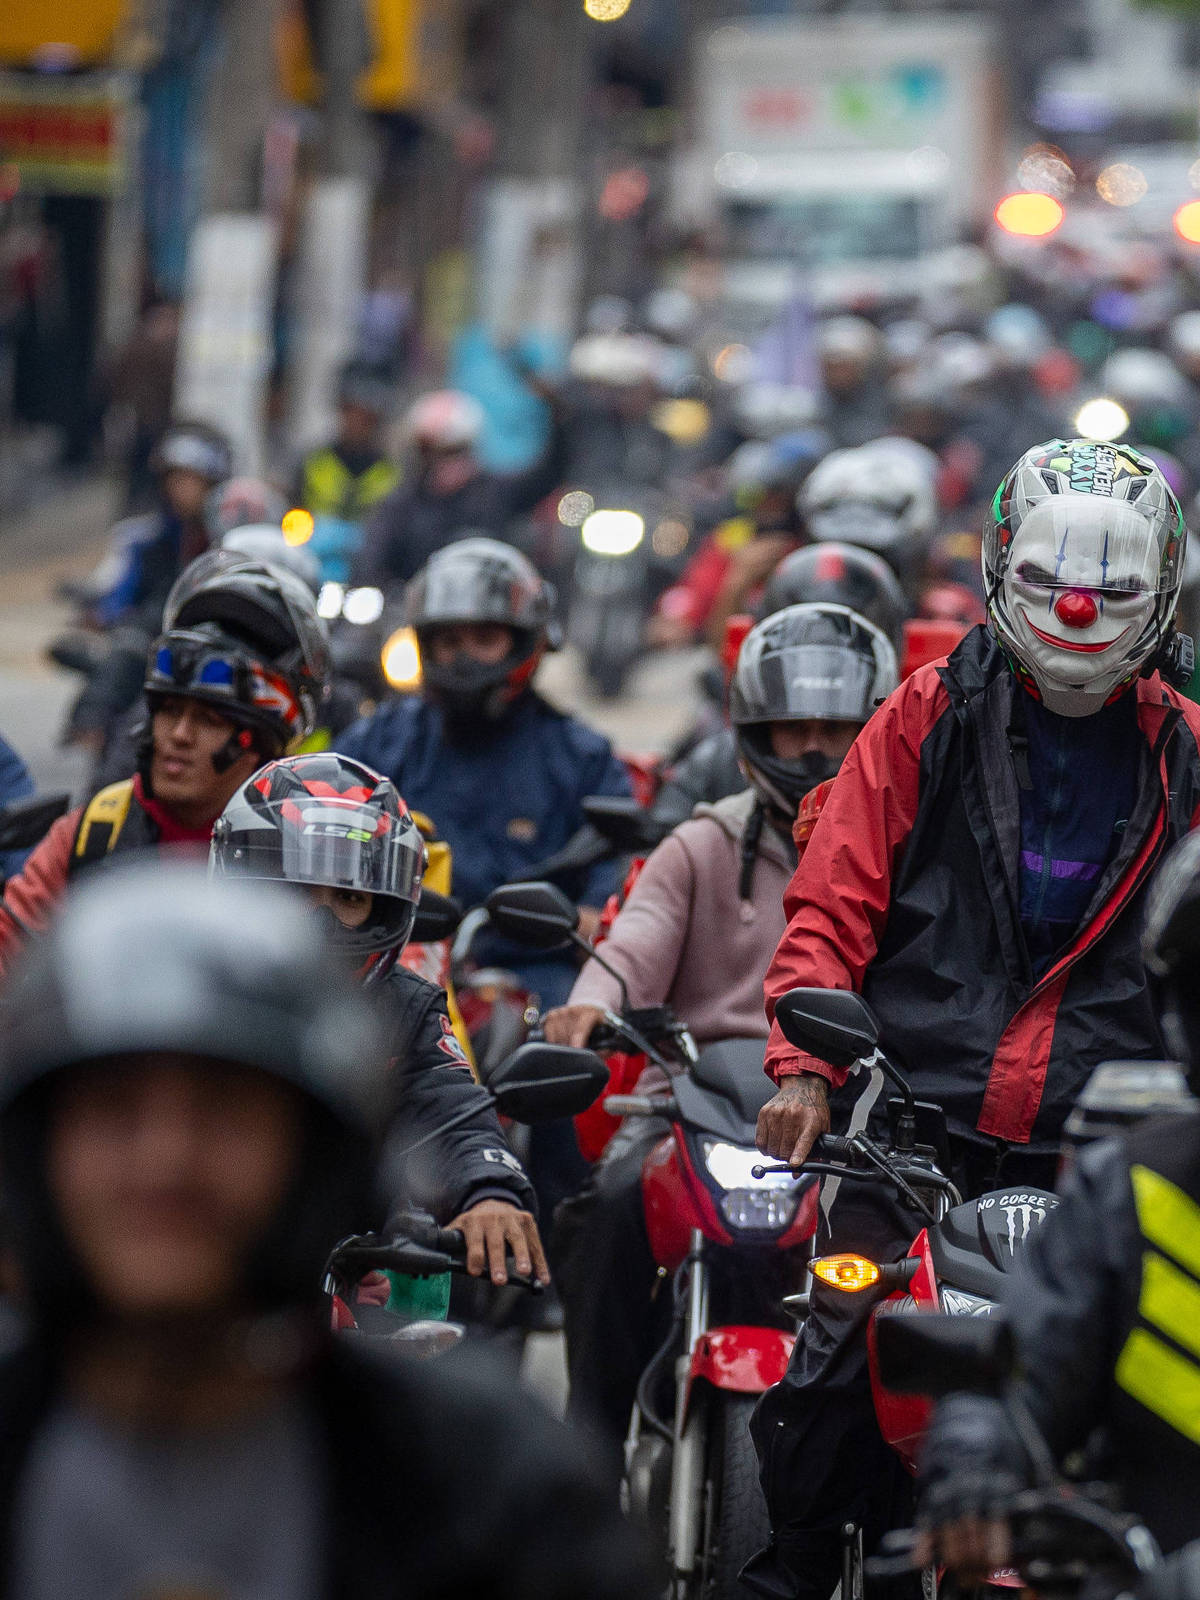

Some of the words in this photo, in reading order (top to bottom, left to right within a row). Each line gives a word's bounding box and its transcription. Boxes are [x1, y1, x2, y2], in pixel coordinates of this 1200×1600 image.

[1091, 445, 1116, 497] HELMETS
[303, 823, 373, 843] LS2
[977, 1198, 996, 1213] NO
[999, 1194, 1047, 1207] CORRE
